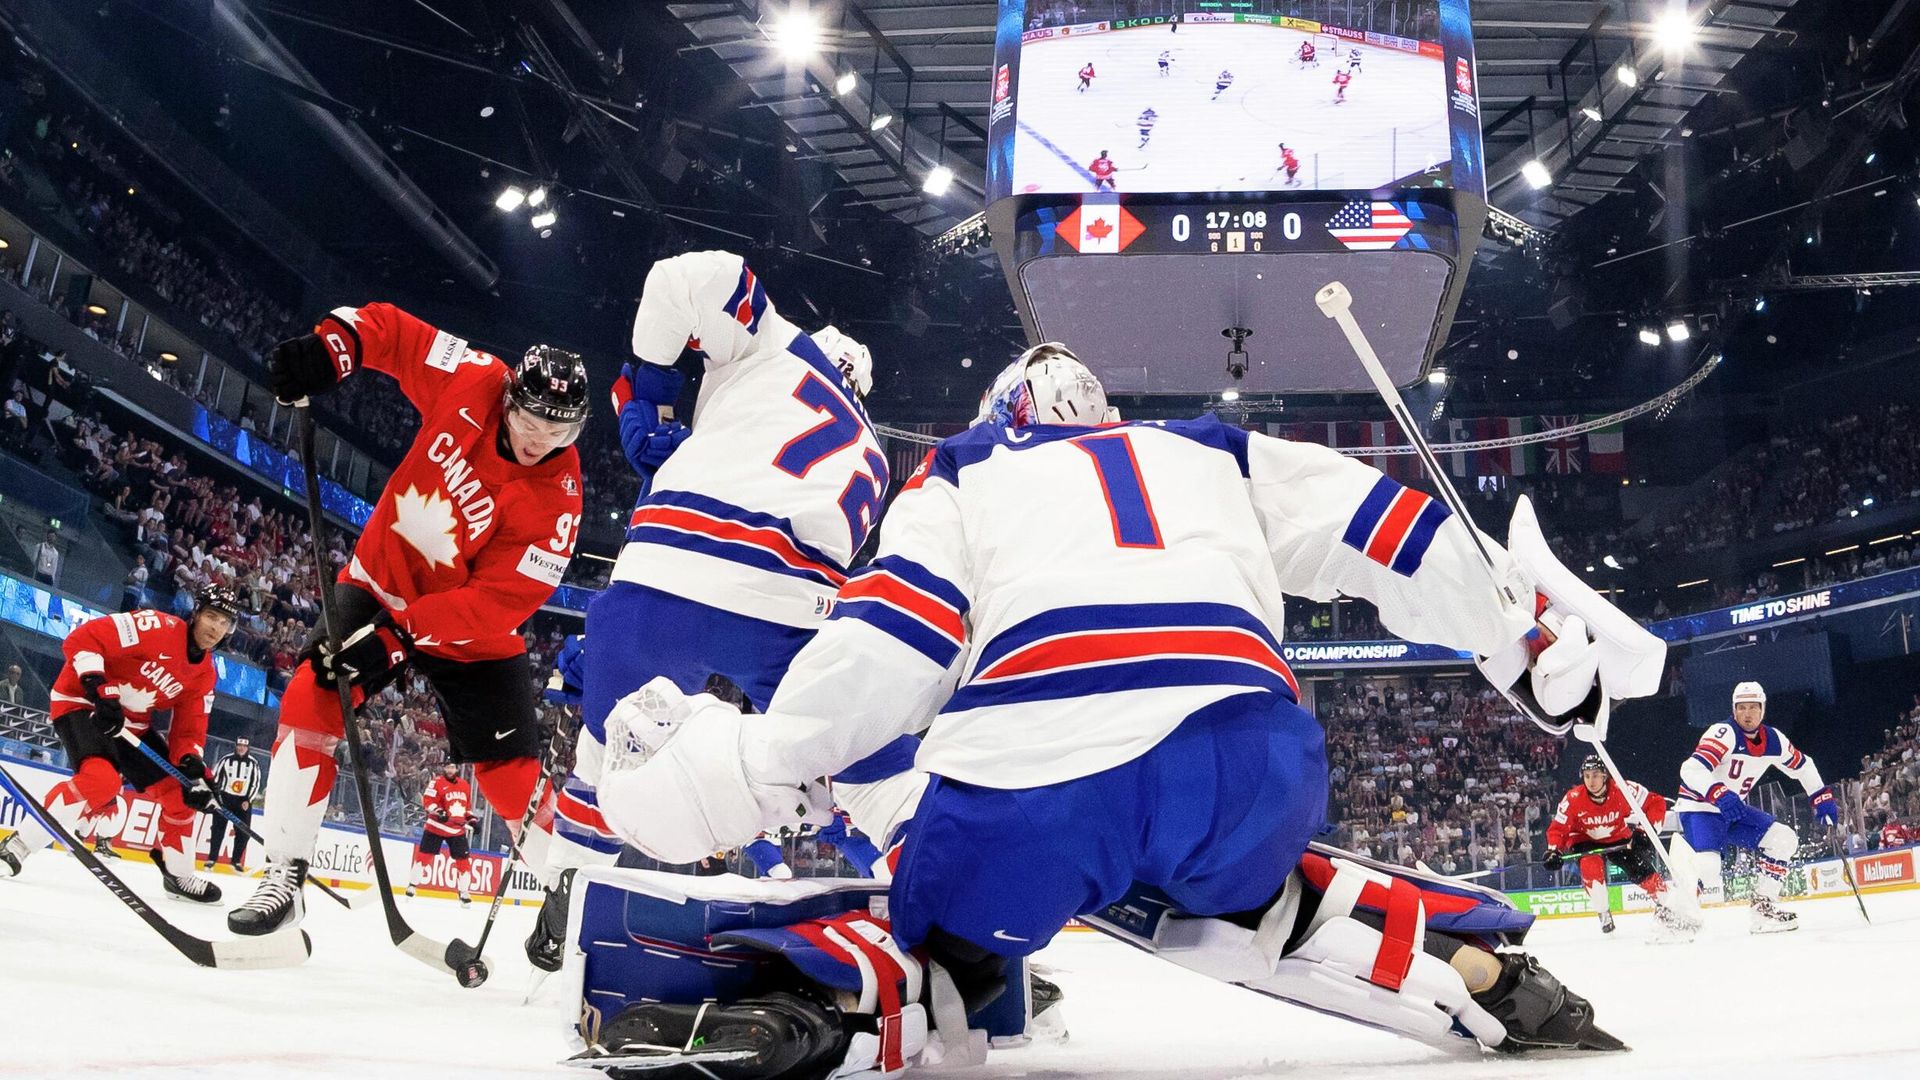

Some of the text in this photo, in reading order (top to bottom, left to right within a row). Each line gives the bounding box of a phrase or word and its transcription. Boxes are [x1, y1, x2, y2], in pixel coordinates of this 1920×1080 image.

[1116, 15, 1176, 29] SKOD
[1328, 26, 1363, 39] STRAUSS
[1172, 214, 1190, 241] 0
[1205, 211, 1267, 228] 17:08
[1283, 212, 1301, 240] 0
[1233, 238, 1239, 249] 1
[837, 357, 855, 378] 72
[550, 377, 568, 393] 93
[545, 407, 577, 419] TELUS
[772, 370, 890, 559] 72
[427, 432, 495, 541] CANADA
[1066, 432, 1166, 550] 1
[1730, 590, 1831, 625] TIME TO SHINE
[1295, 644, 1408, 660] CHAMPIONSHIP
[1714, 727, 1728, 738] 9
[1863, 861, 1903, 881] Malbuner
